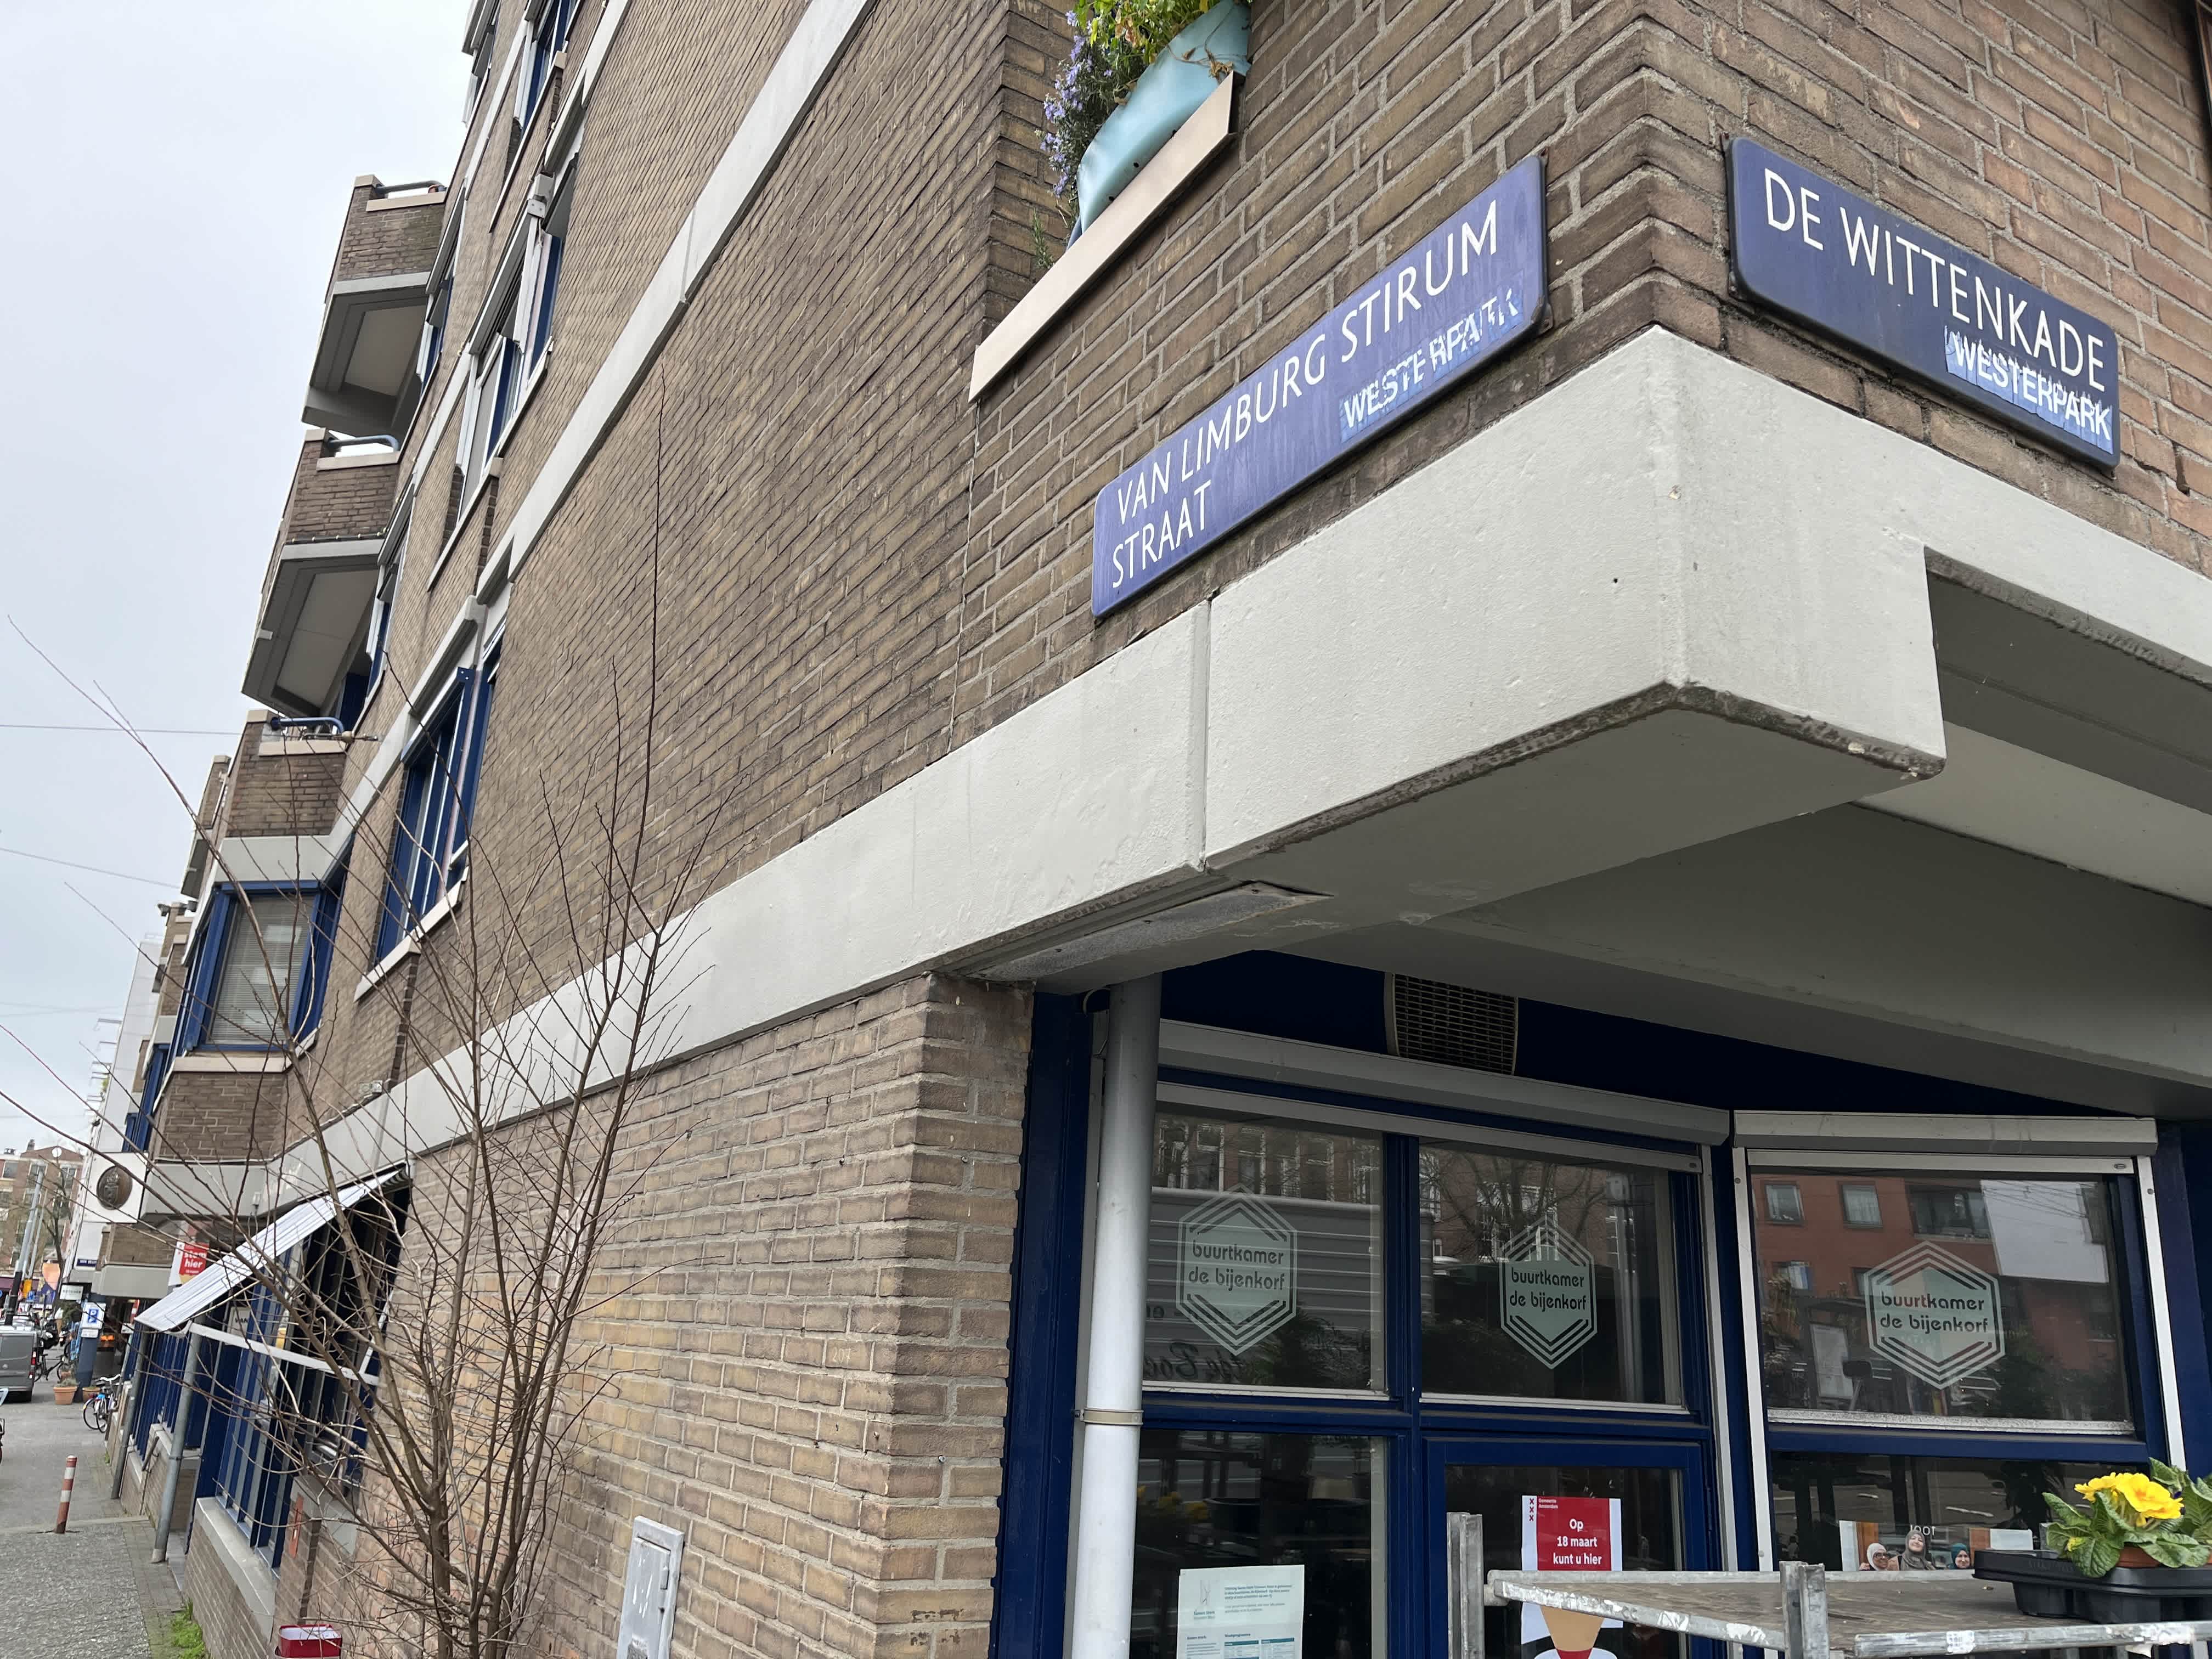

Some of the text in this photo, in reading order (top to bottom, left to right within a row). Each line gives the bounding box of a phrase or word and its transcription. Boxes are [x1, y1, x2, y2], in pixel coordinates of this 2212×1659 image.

[1764, 168, 2106, 393] DE WITTENKADE
[1117, 199, 1497, 525] VAN LIMBURG STIRUM
[1952, 330, 2111, 441] WESTERPARK
[1113, 481, 1211, 589] STRAAT
[1193, 1239, 1284, 1265] buurtkamer
[184, 1258, 204, 1268] hier
[1188, 1266, 1285, 1291] de bijenkorf
[1511, 1267, 1584, 1287] buurtkamer
[1509, 1290, 1587, 1312] de bijenkorf
[1881, 1291, 1984, 1310] buurtkamer
[1880, 1313, 1988, 1334] de bijenkorf
[1569, 1518, 1584, 1532] Op
[1557, 1536, 1598, 1547] 18 maart
[1553, 1553, 1602, 1565] kunt u hier
